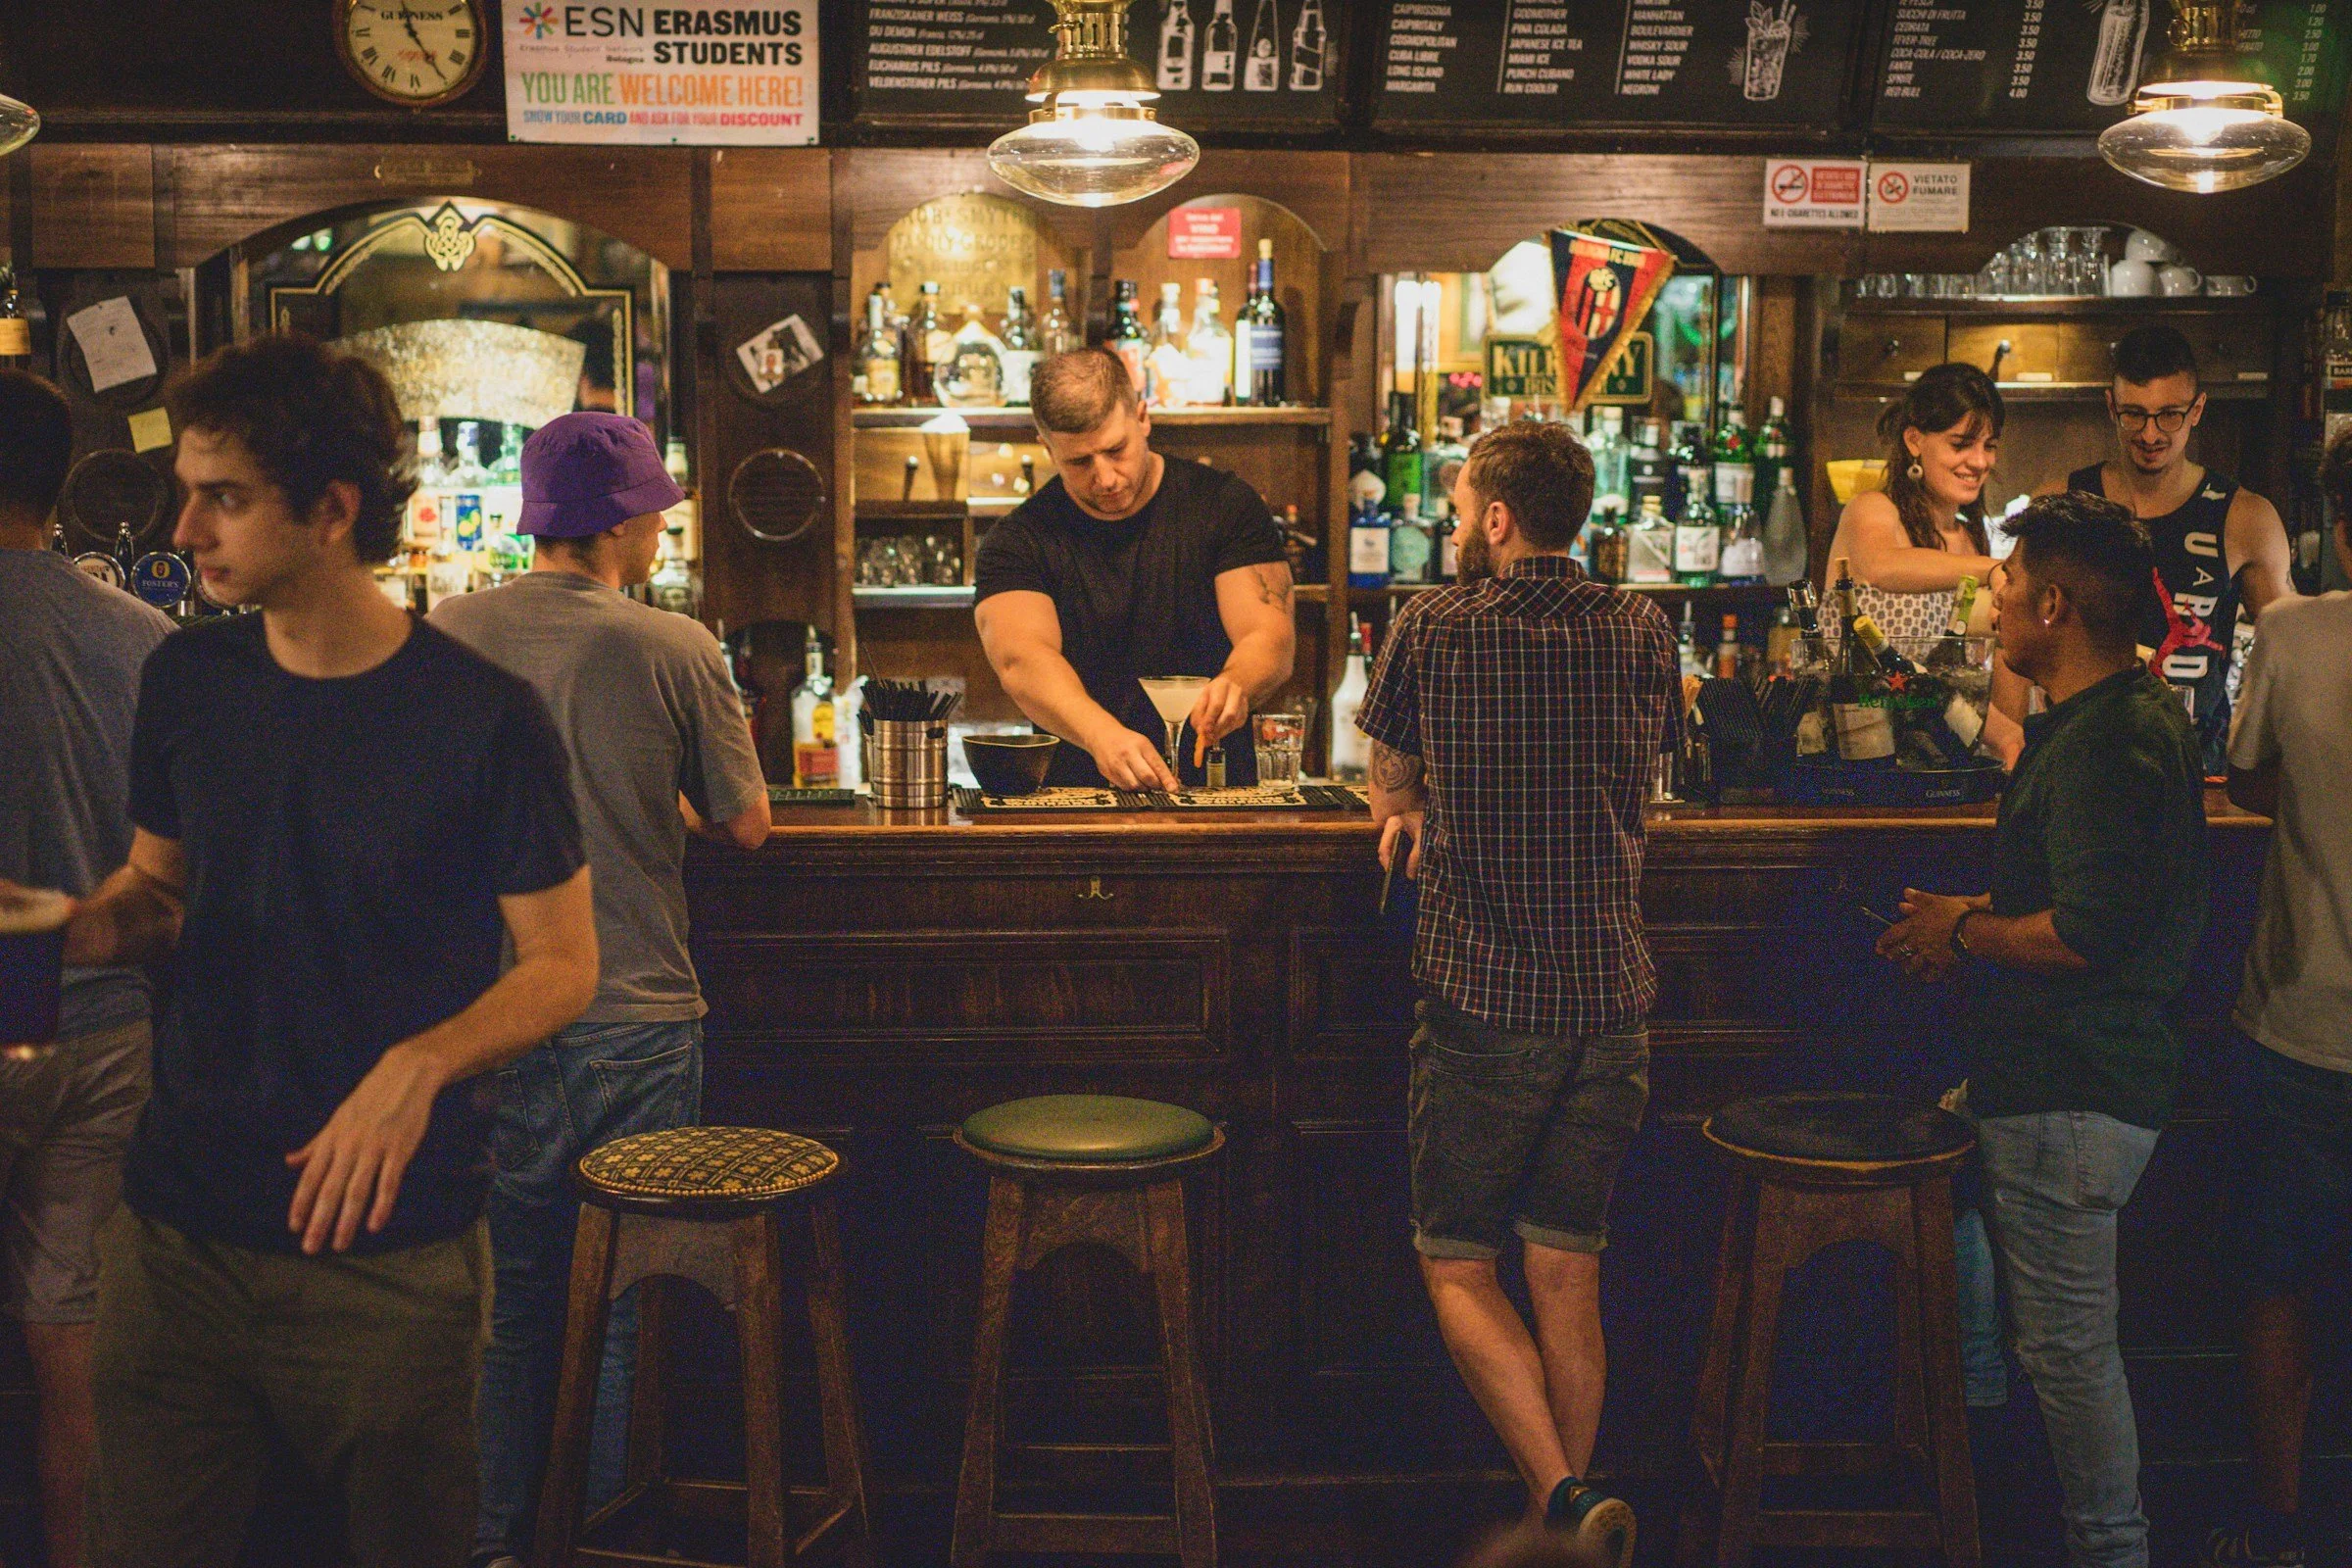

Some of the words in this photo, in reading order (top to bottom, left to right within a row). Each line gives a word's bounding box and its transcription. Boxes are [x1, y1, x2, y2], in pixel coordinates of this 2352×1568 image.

[565, 6, 644, 37] ESN
[654, 10, 803, 36] ERASMUS
[2023, 12, 2042, 24] 3.50
[2021, 24, 2040, 35] 3.50
[1390, 34, 1457, 48] COSMOPOLITAN
[1664, 40, 1689, 52] SOUR
[2018, 37, 2037, 49] 3.50
[654, 41, 804, 66] STUDENTS
[2016, 50, 2035, 62] 3.50
[1656, 55, 1682, 67] SOUR
[2013, 63, 2033, 74] 3.50
[2011, 75, 2031, 86] 3.50
[521, 72, 567, 104] YOU
[572, 73, 615, 105] ARE
[618, 74, 733, 107] WELCOME
[738, 75, 804, 108] HERE!
[2009, 87, 2028, 98] 4.00
[523, 110, 554, 124] SHOW
[556, 111, 581, 124] YOUR
[583, 111, 627, 125] CARD
[720, 113, 804, 126] DISCOUNT
[1913, 174, 1958, 184] VIETATO
[1912, 185, 1958, 195] FUMARE
